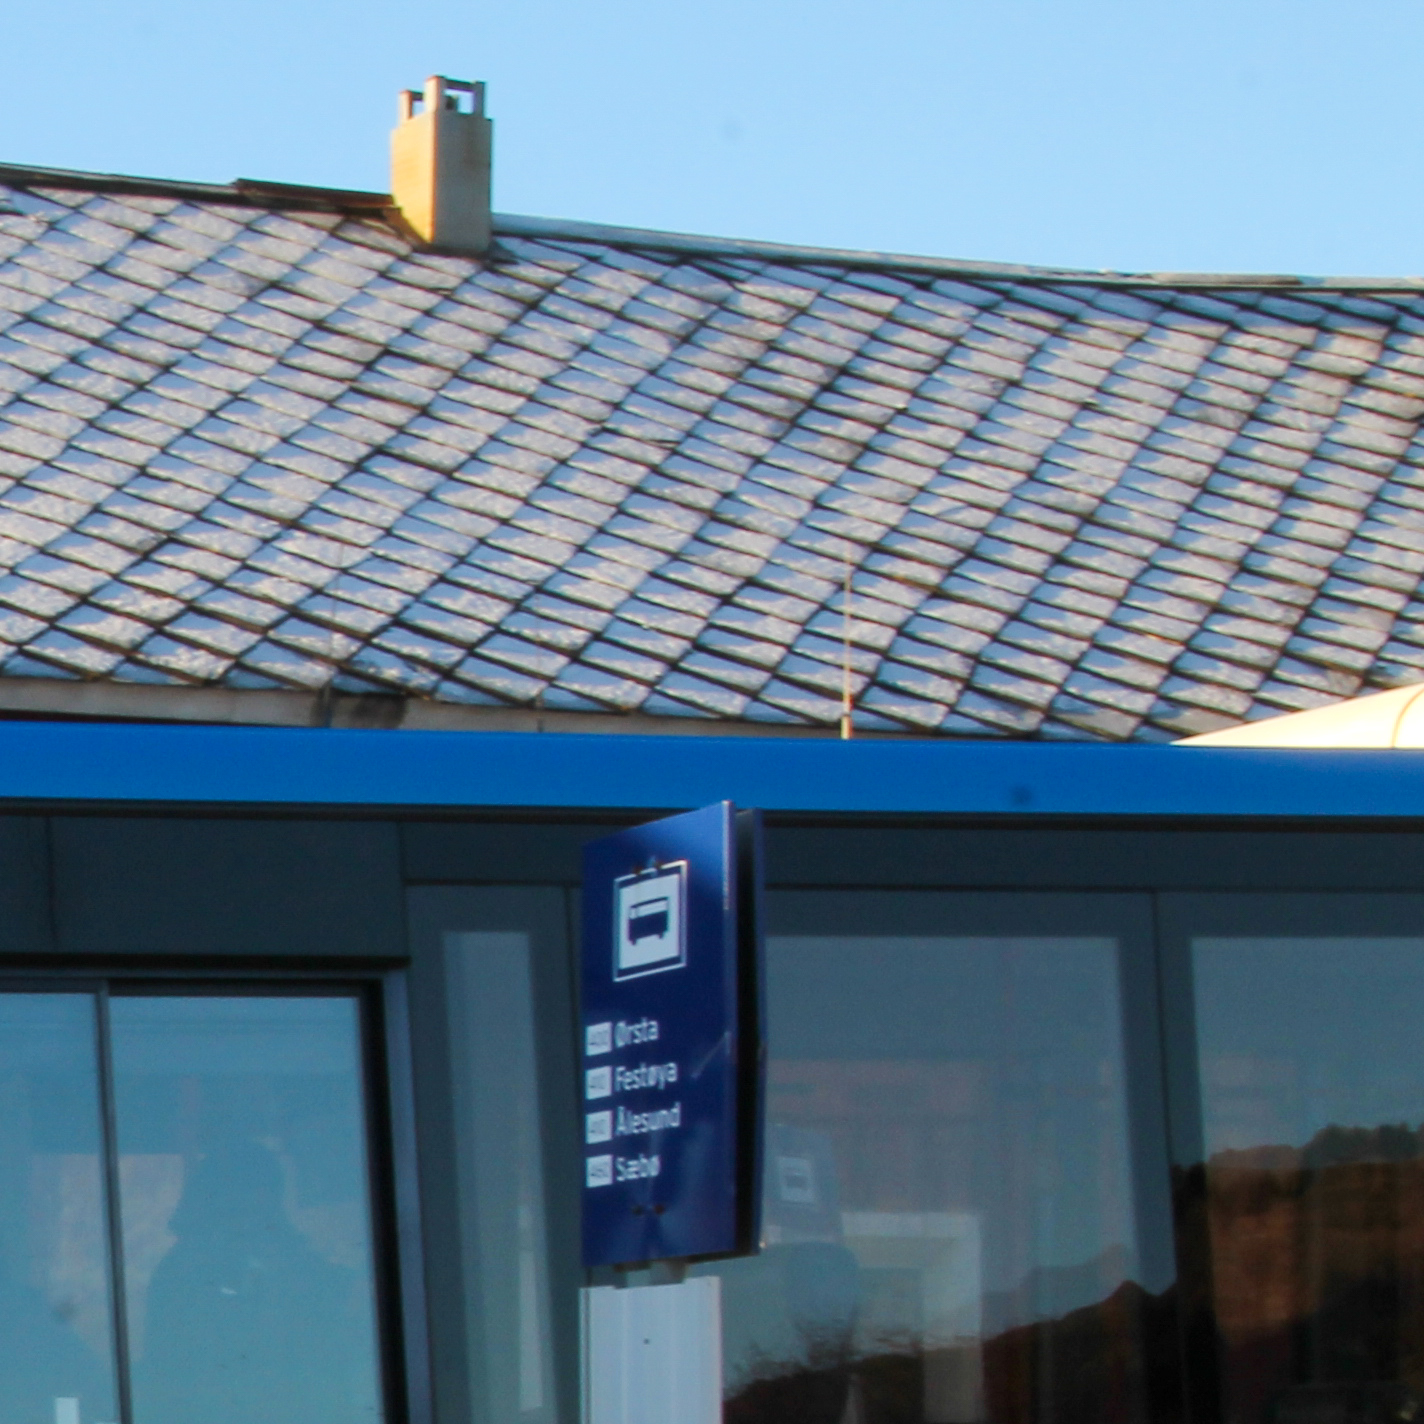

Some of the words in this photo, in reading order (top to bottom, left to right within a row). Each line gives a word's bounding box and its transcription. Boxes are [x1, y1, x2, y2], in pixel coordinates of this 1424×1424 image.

[614, 1017, 659, 1048] Ørsta
[614, 1062, 678, 1092] Festøya
[615, 1101, 681, 1136] Ålesund
[616, 1153, 661, 1182] Sæbø
